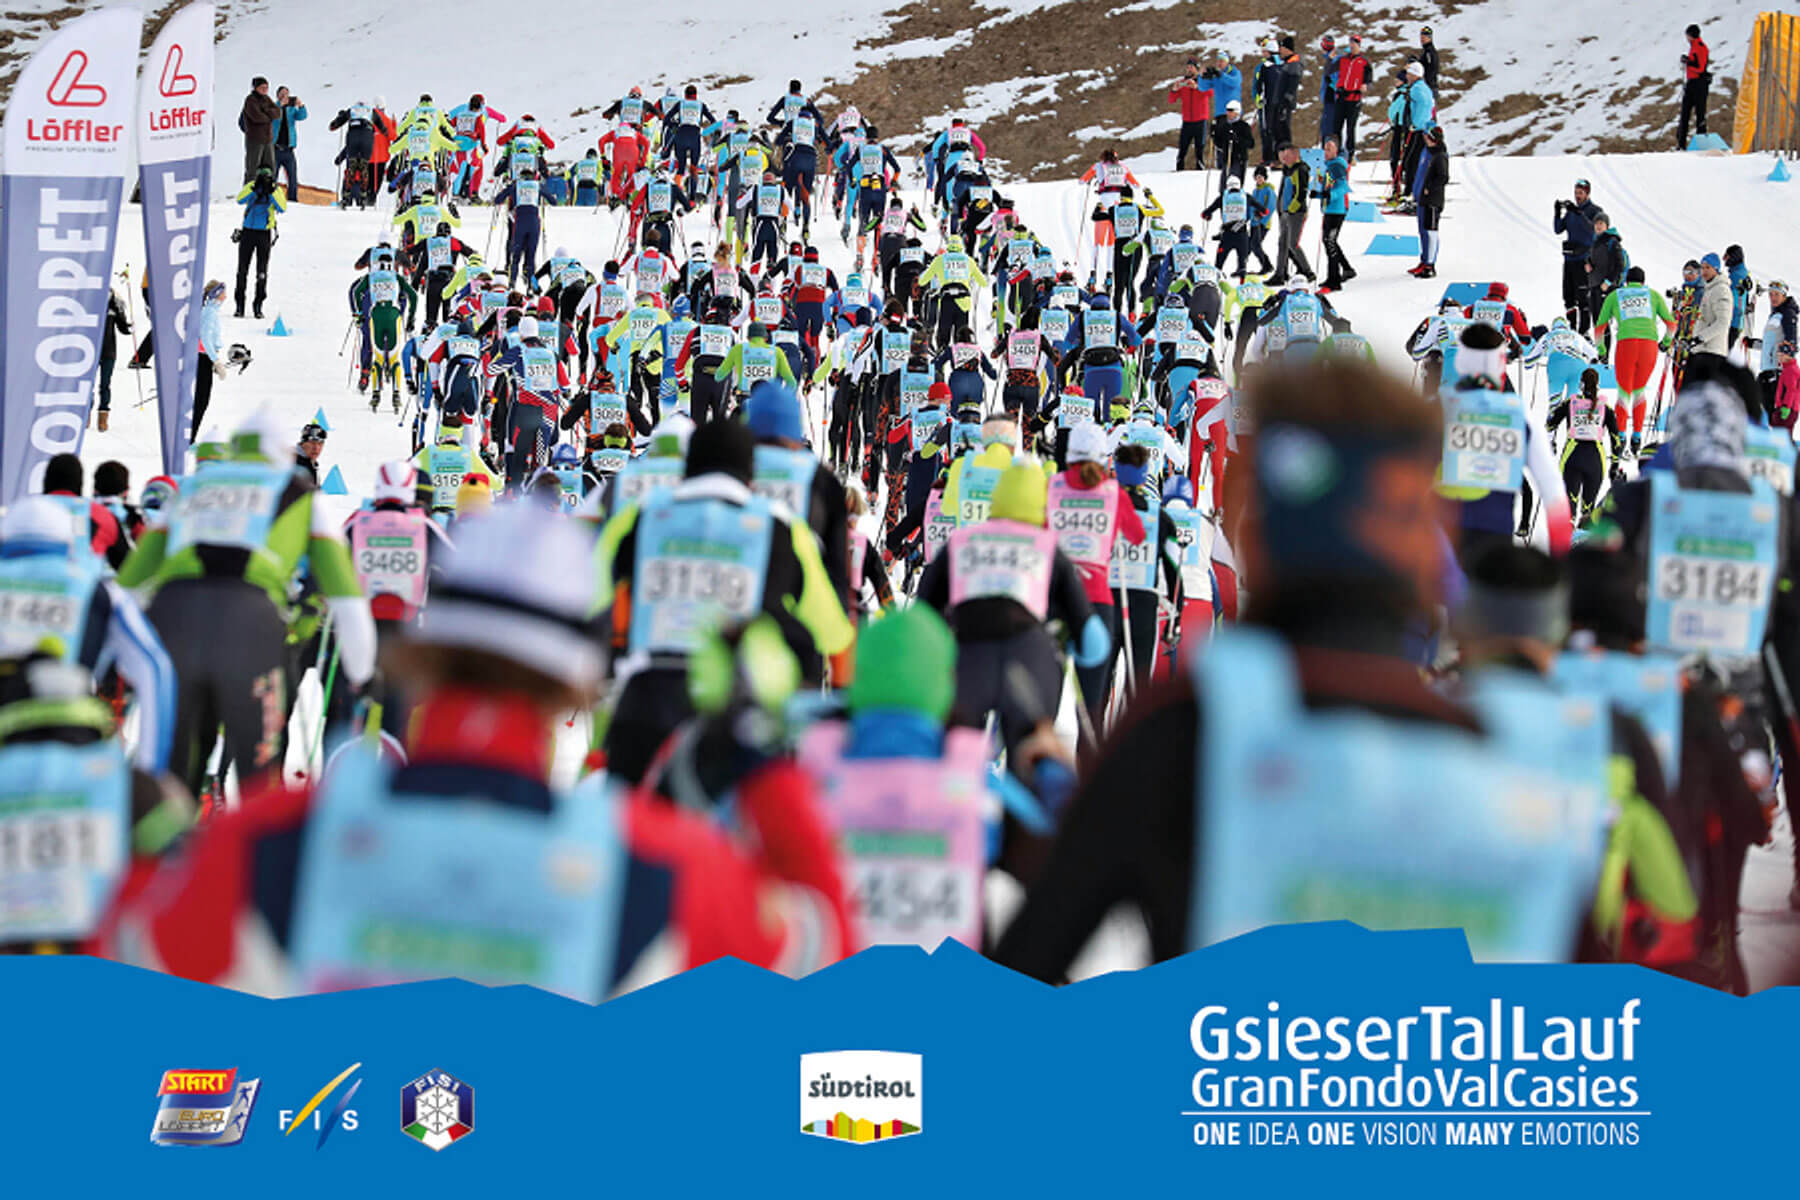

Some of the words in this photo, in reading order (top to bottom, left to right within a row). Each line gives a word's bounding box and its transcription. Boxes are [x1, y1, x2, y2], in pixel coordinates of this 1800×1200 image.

[1010, 344, 1037, 356] 3404
[743, 365, 772, 378] 3054
[1451, 424, 1518, 455] 3059
[963, 502, 986, 521] 31
[1054, 511, 1108, 534] 3449
[928, 525, 950, 542] 34
[1176, 529, 1194, 544] 25
[361, 551, 418, 573] 3468
[644, 558, 749, 611] 3139
[1663, 559, 1759, 605] 3184
[0, 598, 68, 628] 146
[0, 821, 99, 866] 181
[857, 871, 960, 930] 454
